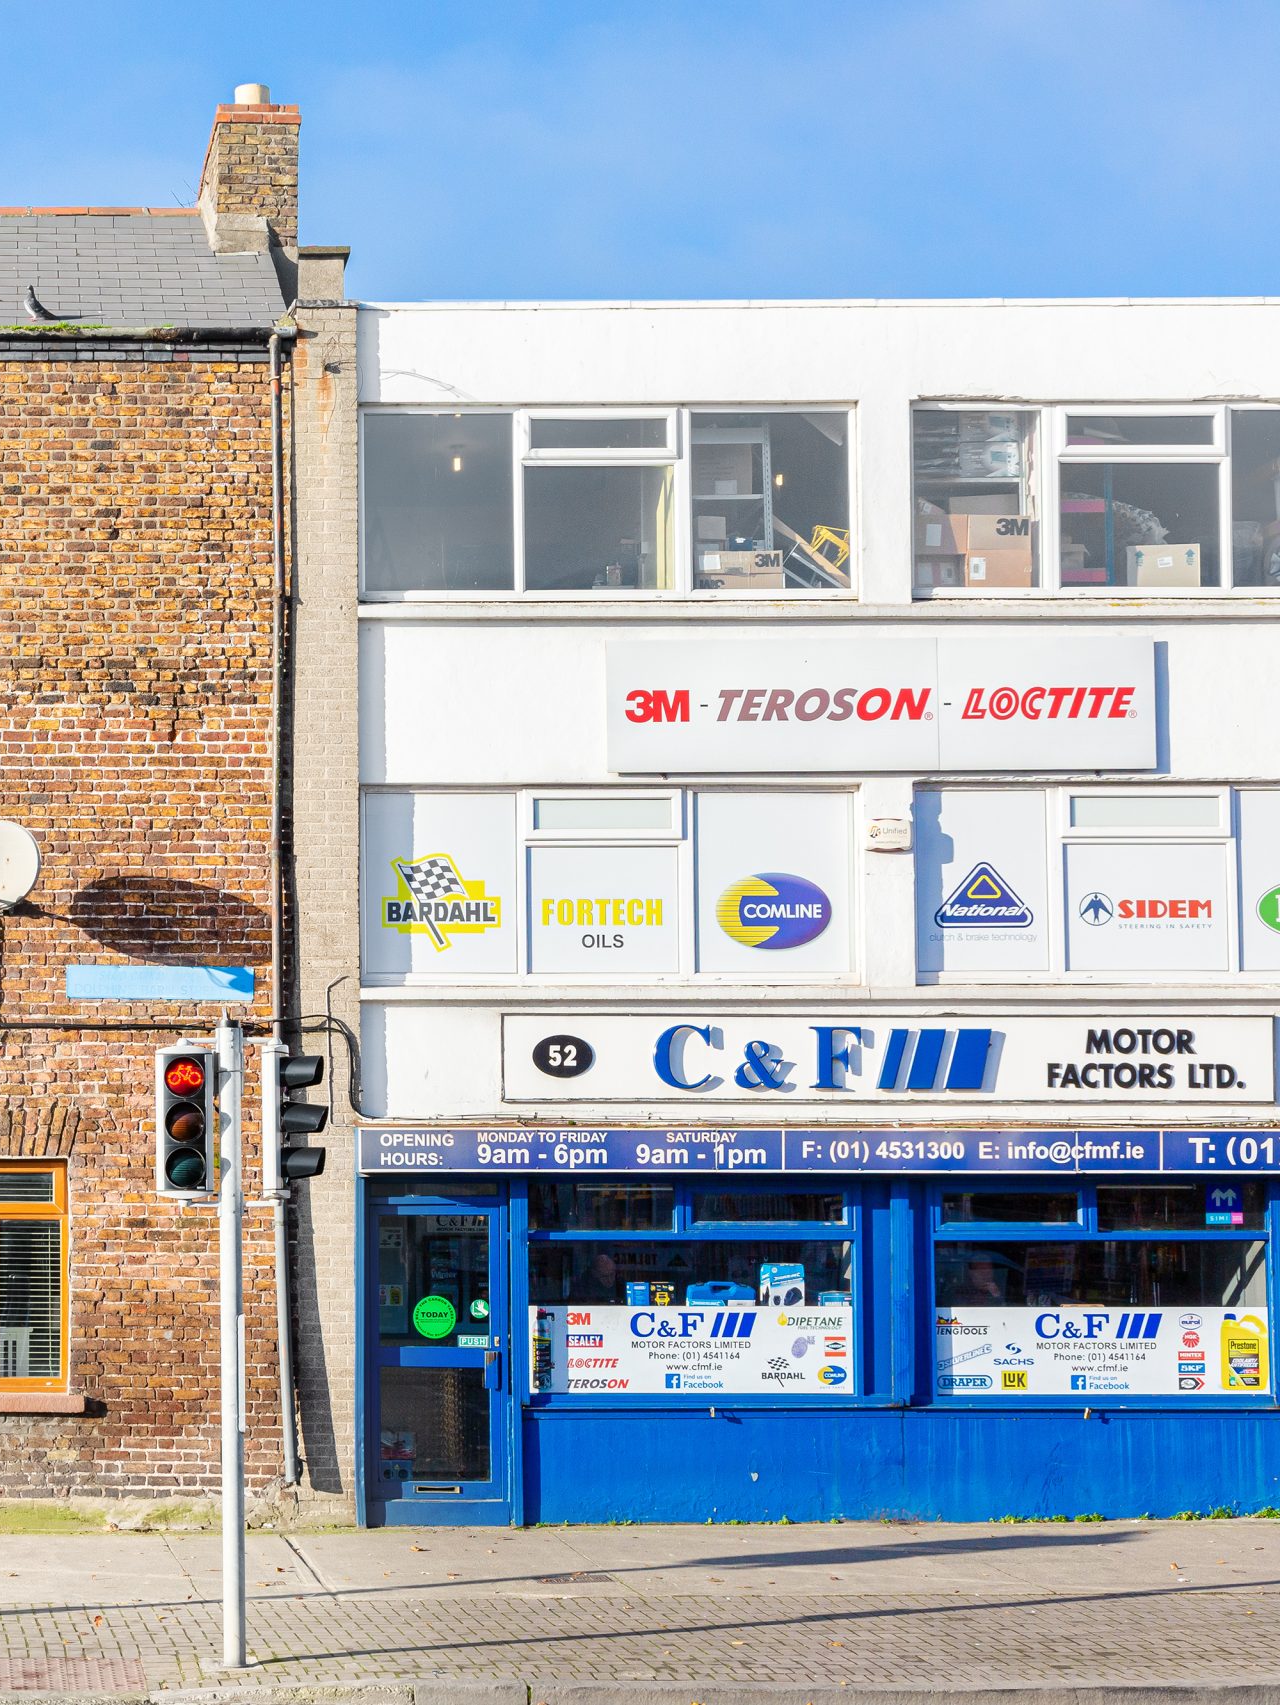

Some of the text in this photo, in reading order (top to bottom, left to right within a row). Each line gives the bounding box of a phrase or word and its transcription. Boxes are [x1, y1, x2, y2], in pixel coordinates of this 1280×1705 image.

[996, 518, 1029, 536] 3M
[755, 553, 780, 568] 3M
[625, 690, 690, 723] 3M
[387, 902, 496, 922] BARDAHL
[541, 898, 663, 926] FORTECH
[743, 903, 822, 919] COMLINE
[940, 903, 1027, 917] National
[1117, 899, 1212, 919] SIDEM
[581, 934, 624, 948] OILS
[929, 932, 1038, 943] clutch & brake technology
[1085, 1028, 1197, 1054] MOTOR
[548, 1045, 577, 1067] 52
[1047, 1062, 1245, 1089] FACTORS LTD.
[380, 1134, 454, 1147] OPENING
[477, 1132, 608, 1143] MONDAY TO FRIDAY
[666, 1132, 738, 1143] SATURDAY
[477, 1143, 530, 1165] 9am
[554, 1143, 608, 1168] 6pm
[636, 1143, 689, 1165] 9am
[715, 1143, 767, 1168] 1pm
[802, 1141, 1144, 1164] F: (01) 4531300 E: info@cfmf.ie
[1188, 1136, 1280, 1166] T: (01
[380, 1153, 444, 1166] HOURS:
[566, 1312, 591, 1326] 3M
[630, 1312, 704, 1338] C&F
[787, 1316, 844, 1326] DIPETANE
[1035, 1313, 1110, 1339] C&F
[461, 1336, 486, 1345] PUSH
[568, 1335, 601, 1347] SEALEY
[631, 1341, 751, 1349] MOTOR FACTORS LIMITED
[1036, 1342, 1157, 1350] MOTOR FACTORS LIMITED
[1230, 1340, 1257, 1350] Prestone
[567, 1358, 620, 1368] LOCTITE
[648, 1352, 740, 1361] Phone: (01) 4541164
[993, 1358, 1035, 1366] SACHS
[1053, 1353, 1146, 1362] Phone: (01) 4541164
[666, 1362, 723, 1371] www.cfmf.ie
[1071, 1364, 1129, 1372] www.cfmf.ie
[761, 1372, 806, 1380] BARDAHL
[942, 1377, 988, 1387] DRAPER
[567, 1379, 629, 1389] TEROSON
[683, 1380, 724, 1389] Facebook
[1089, 1382, 1130, 1390] Facebook
